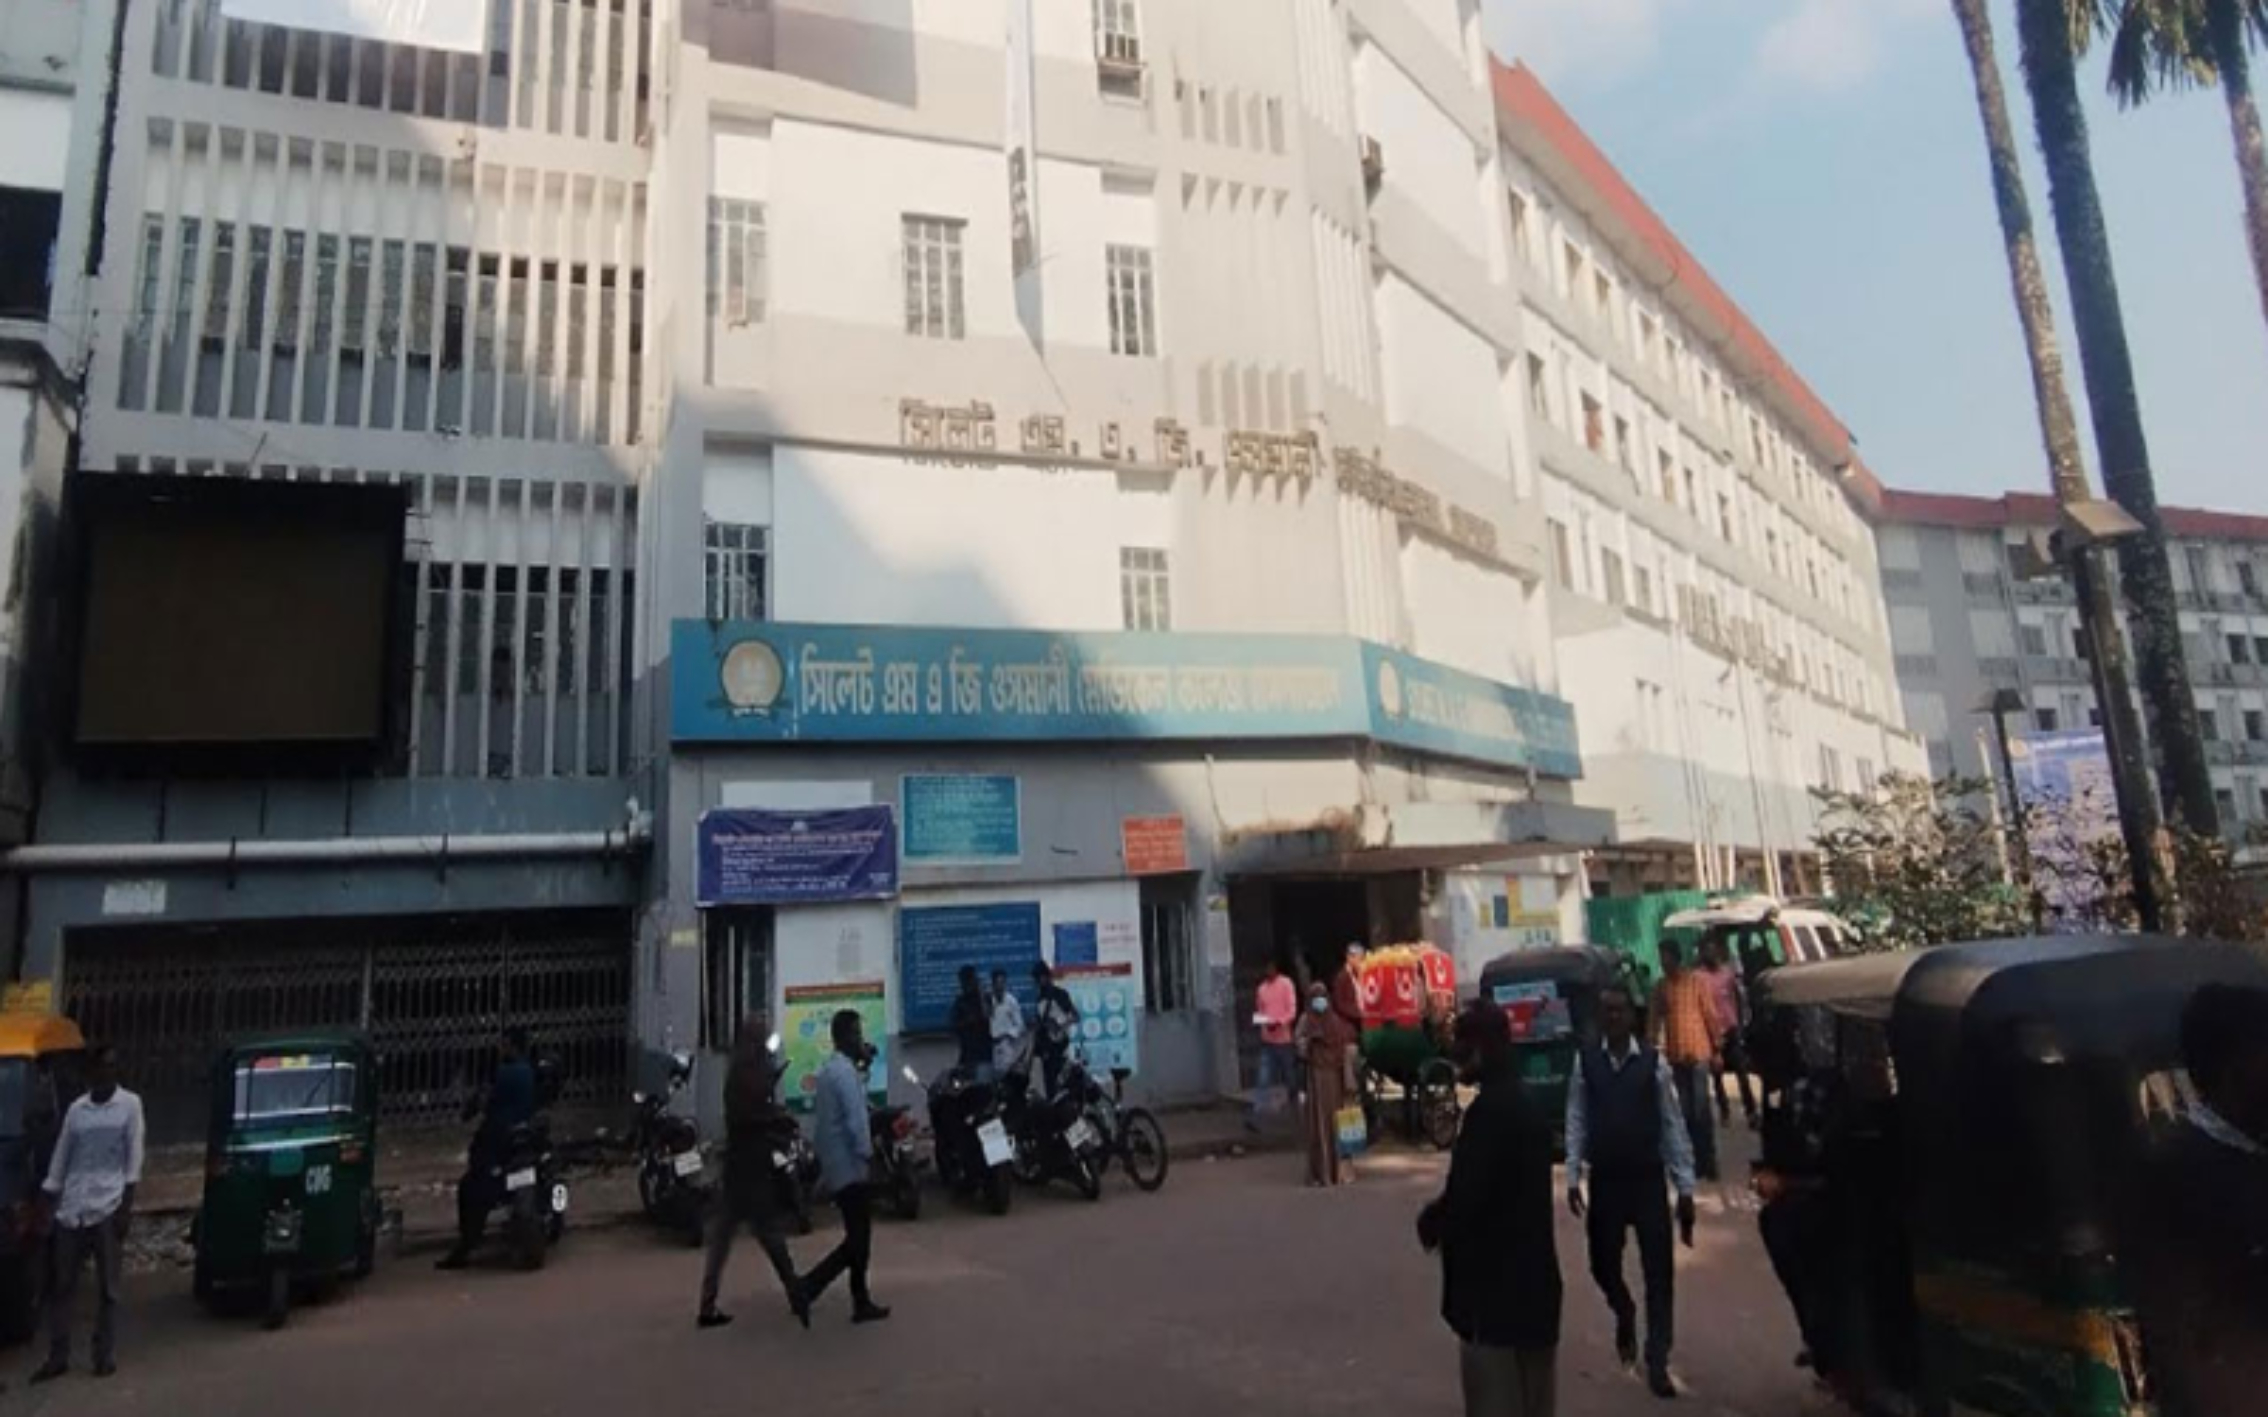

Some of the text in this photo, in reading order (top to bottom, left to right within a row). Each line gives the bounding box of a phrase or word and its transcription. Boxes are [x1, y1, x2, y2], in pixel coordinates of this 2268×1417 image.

[799, 641, 874, 715] সিলেট
[882, 661, 918, 715] এম
[925, 662, 943, 715] এ
[949, 645, 983, 715] জি
[989, 644, 1071, 715] ওসমানী
